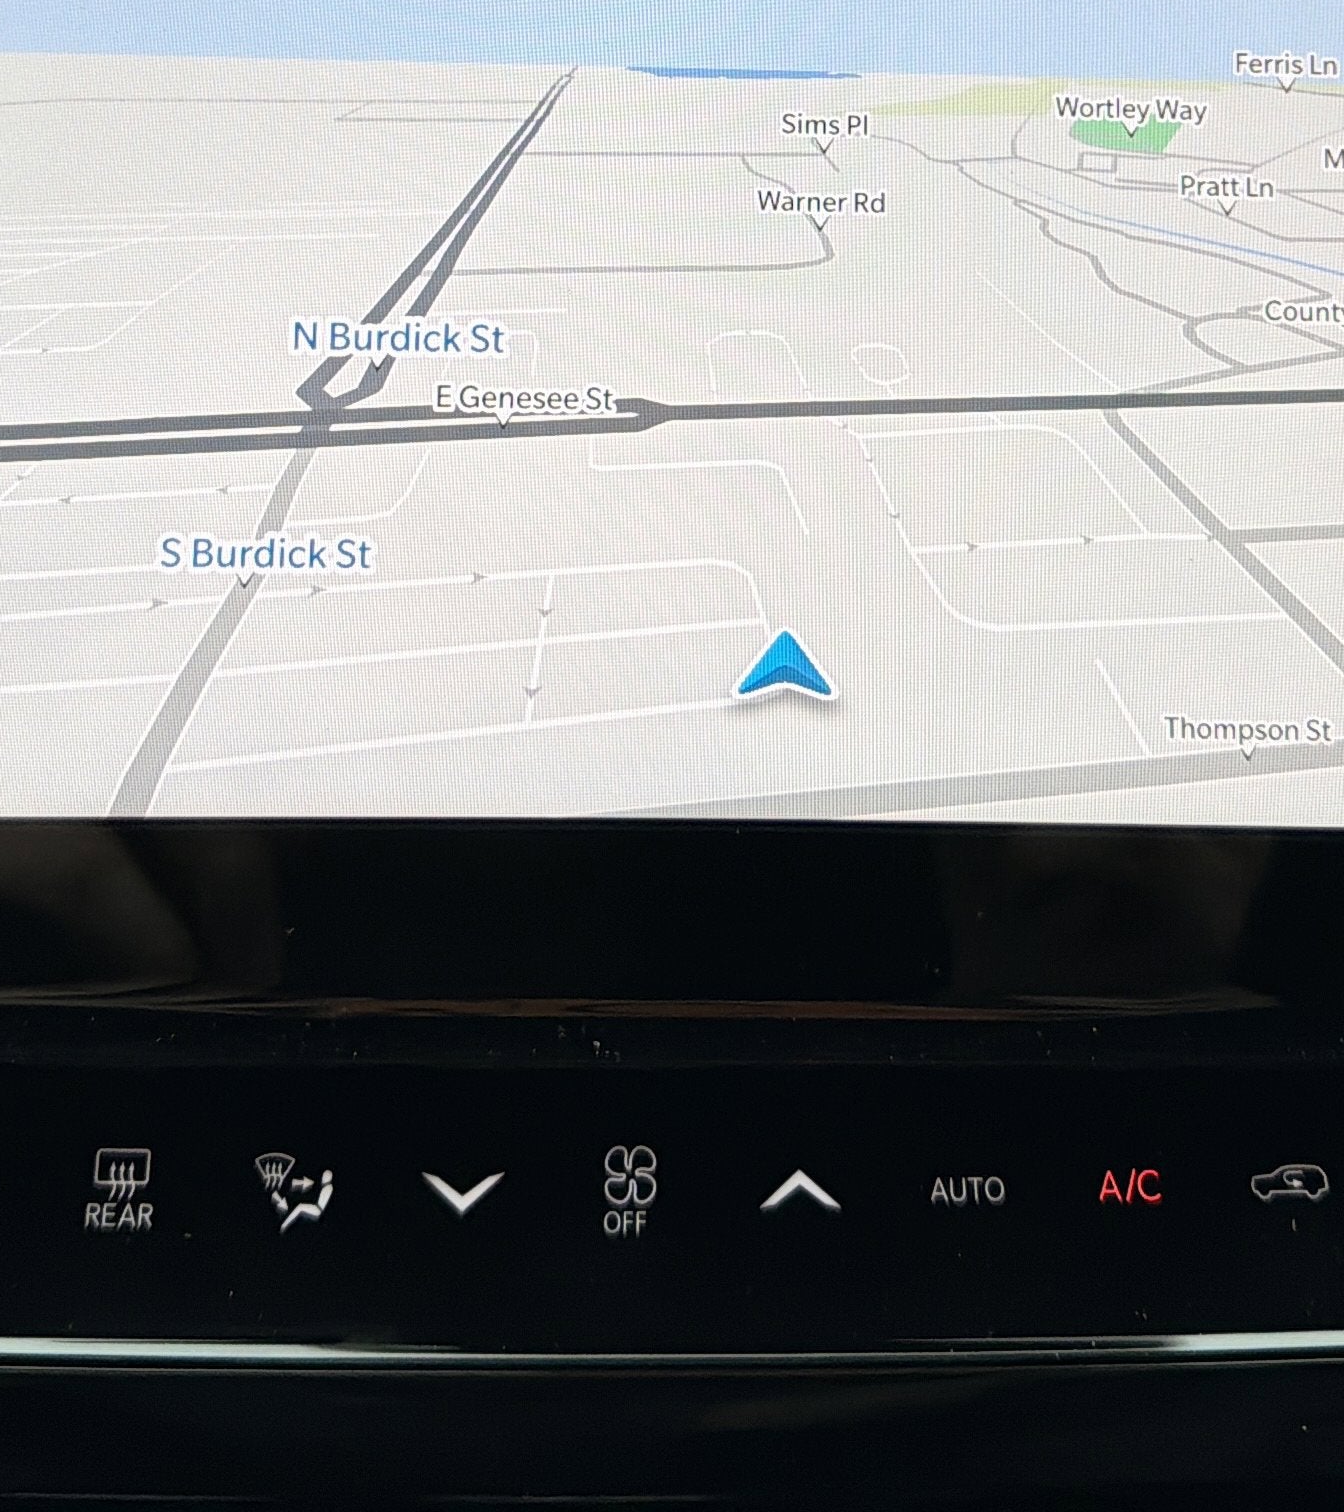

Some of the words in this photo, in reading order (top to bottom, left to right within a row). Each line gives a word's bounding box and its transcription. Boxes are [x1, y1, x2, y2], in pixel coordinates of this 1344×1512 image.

[1234, 53, 1302, 76] Ferris
[1309, 54, 1339, 76] Ln
[1056, 96, 1149, 122] Wortley
[1155, 99, 1207, 125] Way
[782, 112, 840, 137] Sims
[846, 112, 869, 136] Pl
[1180, 176, 1237, 197] Pratt
[1244, 177, 1274, 198] Ln
[758, 190, 847, 213] Warner
[852, 192, 885, 214] Rd
[294, 323, 318, 351] N
[329, 322, 460, 354] Burdick
[469, 325, 505, 355] St
[437, 386, 451, 410] E
[459, 386, 577, 411] Genesee
[585, 388, 612, 411] St
[161, 540, 182, 568] S
[192, 538, 327, 568] Burdick
[335, 540, 372, 569] St
[1166, 718, 1299, 746] Thompson
[1306, 718, 1331, 742] St
[931, 1175, 1006, 1203] AUTO
[1100, 1170, 1163, 1203] A/C
[85, 1202, 154, 1229] REAR
[604, 1211, 647, 1235] OFF
